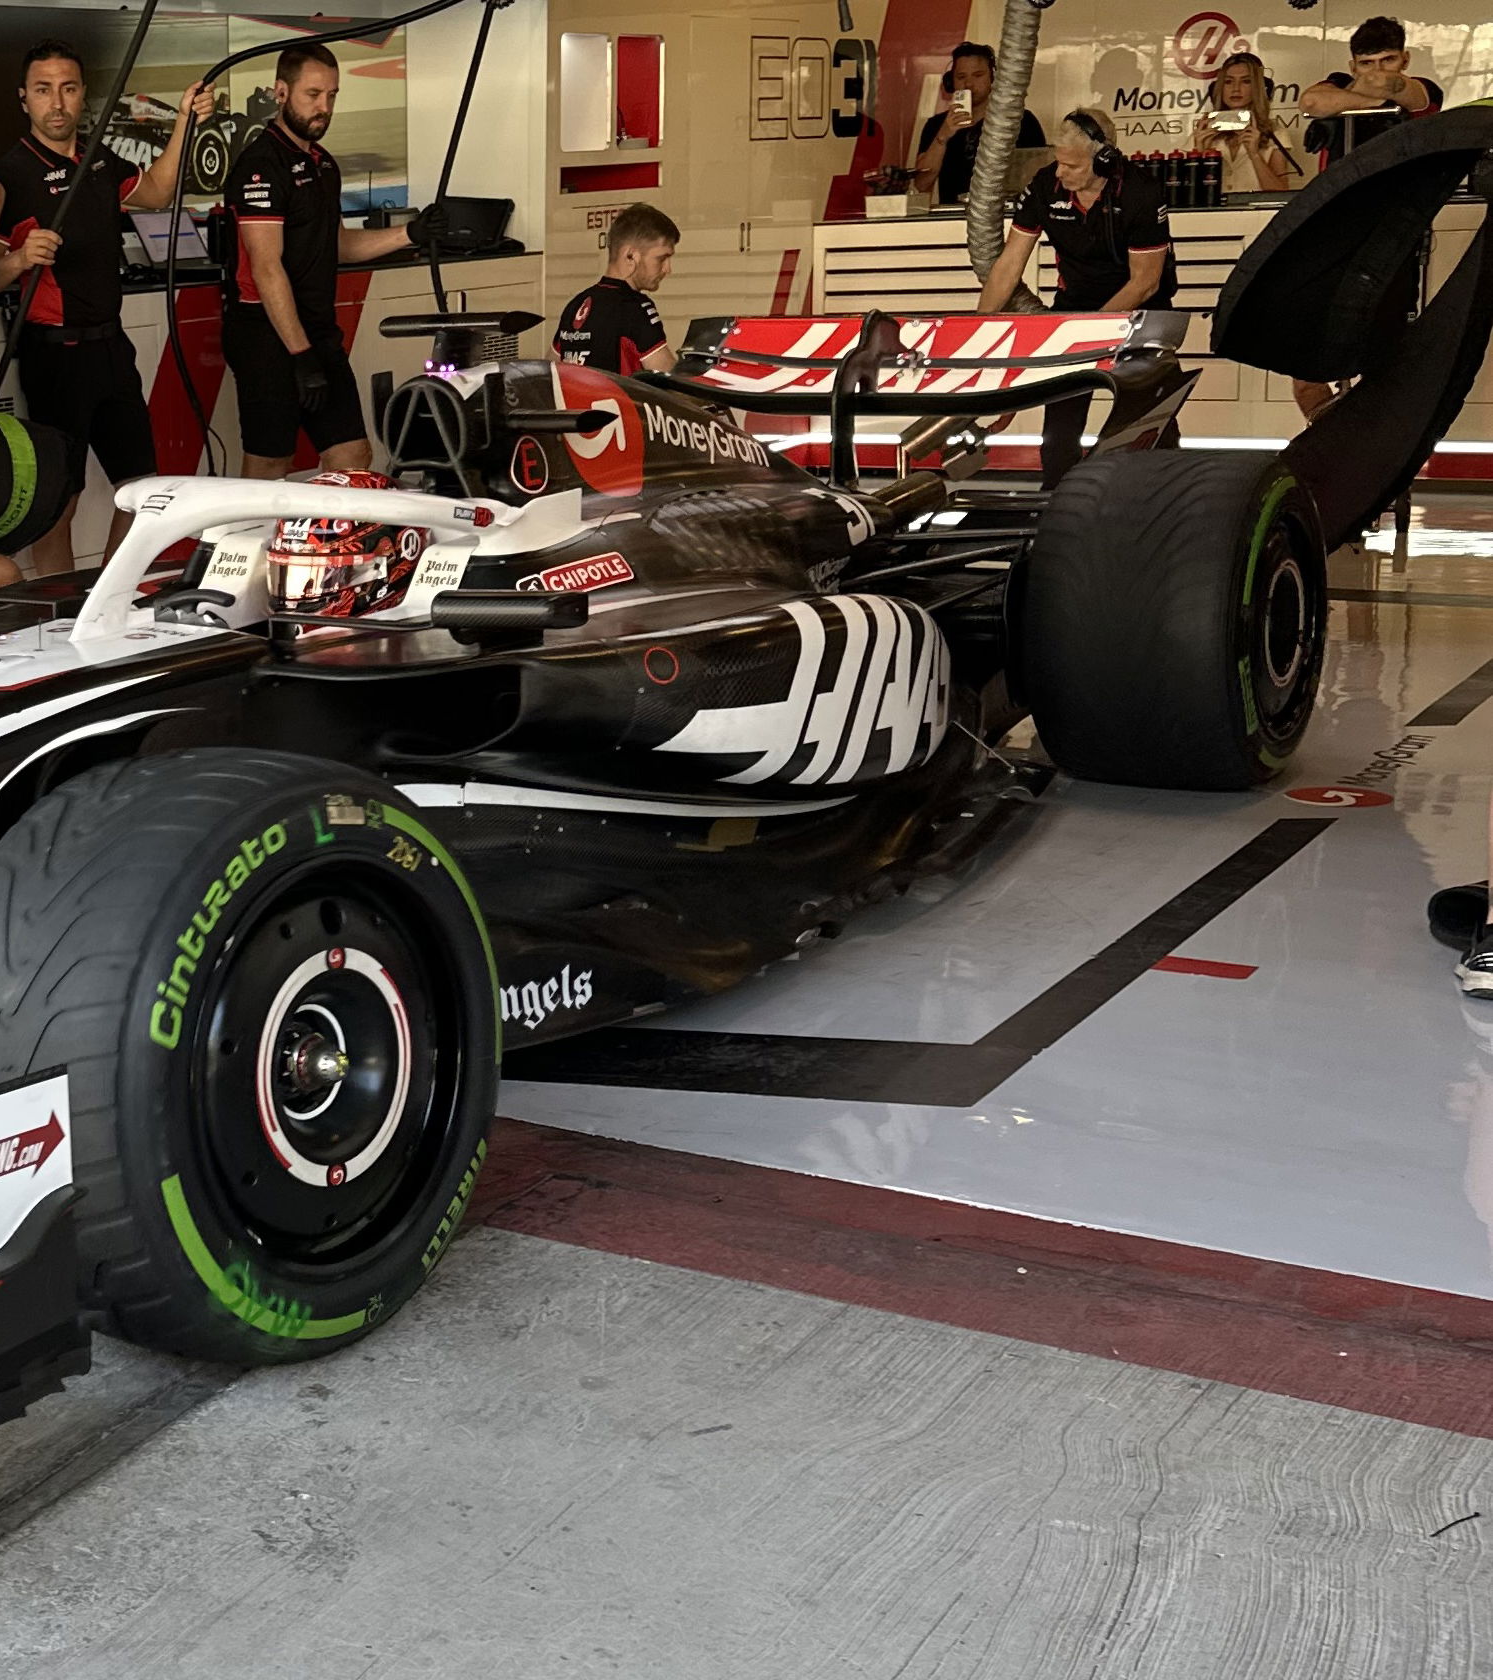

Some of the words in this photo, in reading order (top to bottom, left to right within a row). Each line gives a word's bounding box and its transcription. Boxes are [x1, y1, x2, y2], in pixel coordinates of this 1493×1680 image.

[643, 402, 770, 467] MoneyGram
[218, 551, 248, 564] Palm
[209, 563, 248, 577] Angels
[426, 559, 458, 573] Palm
[416, 573, 458, 588] Angels
[548, 558, 628, 592] CHIPOTLE
[500, 963, 593, 1030] ngels
